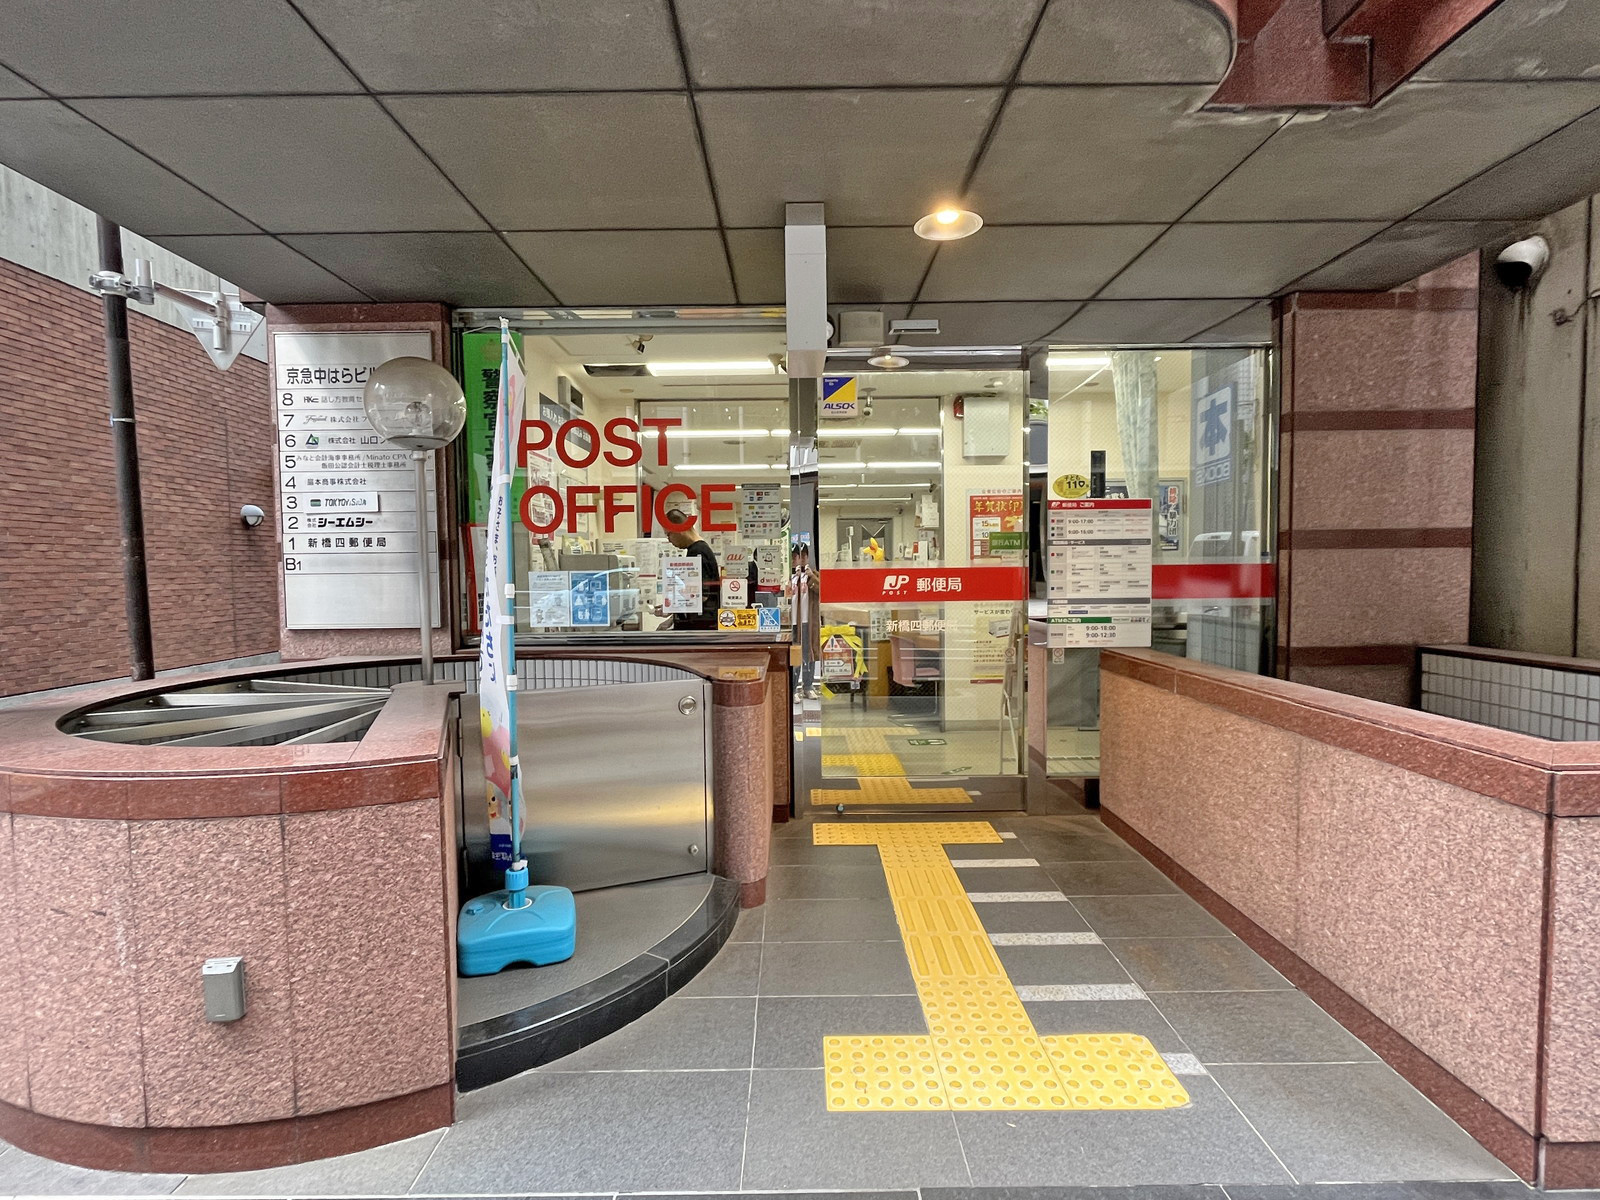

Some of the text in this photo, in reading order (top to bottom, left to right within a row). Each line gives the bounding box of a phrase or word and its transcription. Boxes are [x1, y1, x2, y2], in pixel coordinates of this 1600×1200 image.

[282, 392, 294, 406] 8
[823, 402, 855, 410] ALSOK
[283, 414, 295, 427] 7
[284, 434, 296, 448] 6
[517, 417, 682, 468] POST
[285, 455, 296, 468] 5
[285, 476, 296, 489] 4
[286, 496, 297, 509] 3
[519, 483, 737, 534] OFFICE
[974, 500, 1023, 512] 年賀状印
[288, 516, 299, 529] 2
[318, 517, 373, 528] シーエムシー
[288, 537, 295, 550] 1
[308, 537, 387, 548] 新橋四郵便局
[726, 553, 745, 561] au
[285, 558, 302, 571] B1
[883, 575, 910, 590] JP
[916, 577, 962, 592] 郵便局
